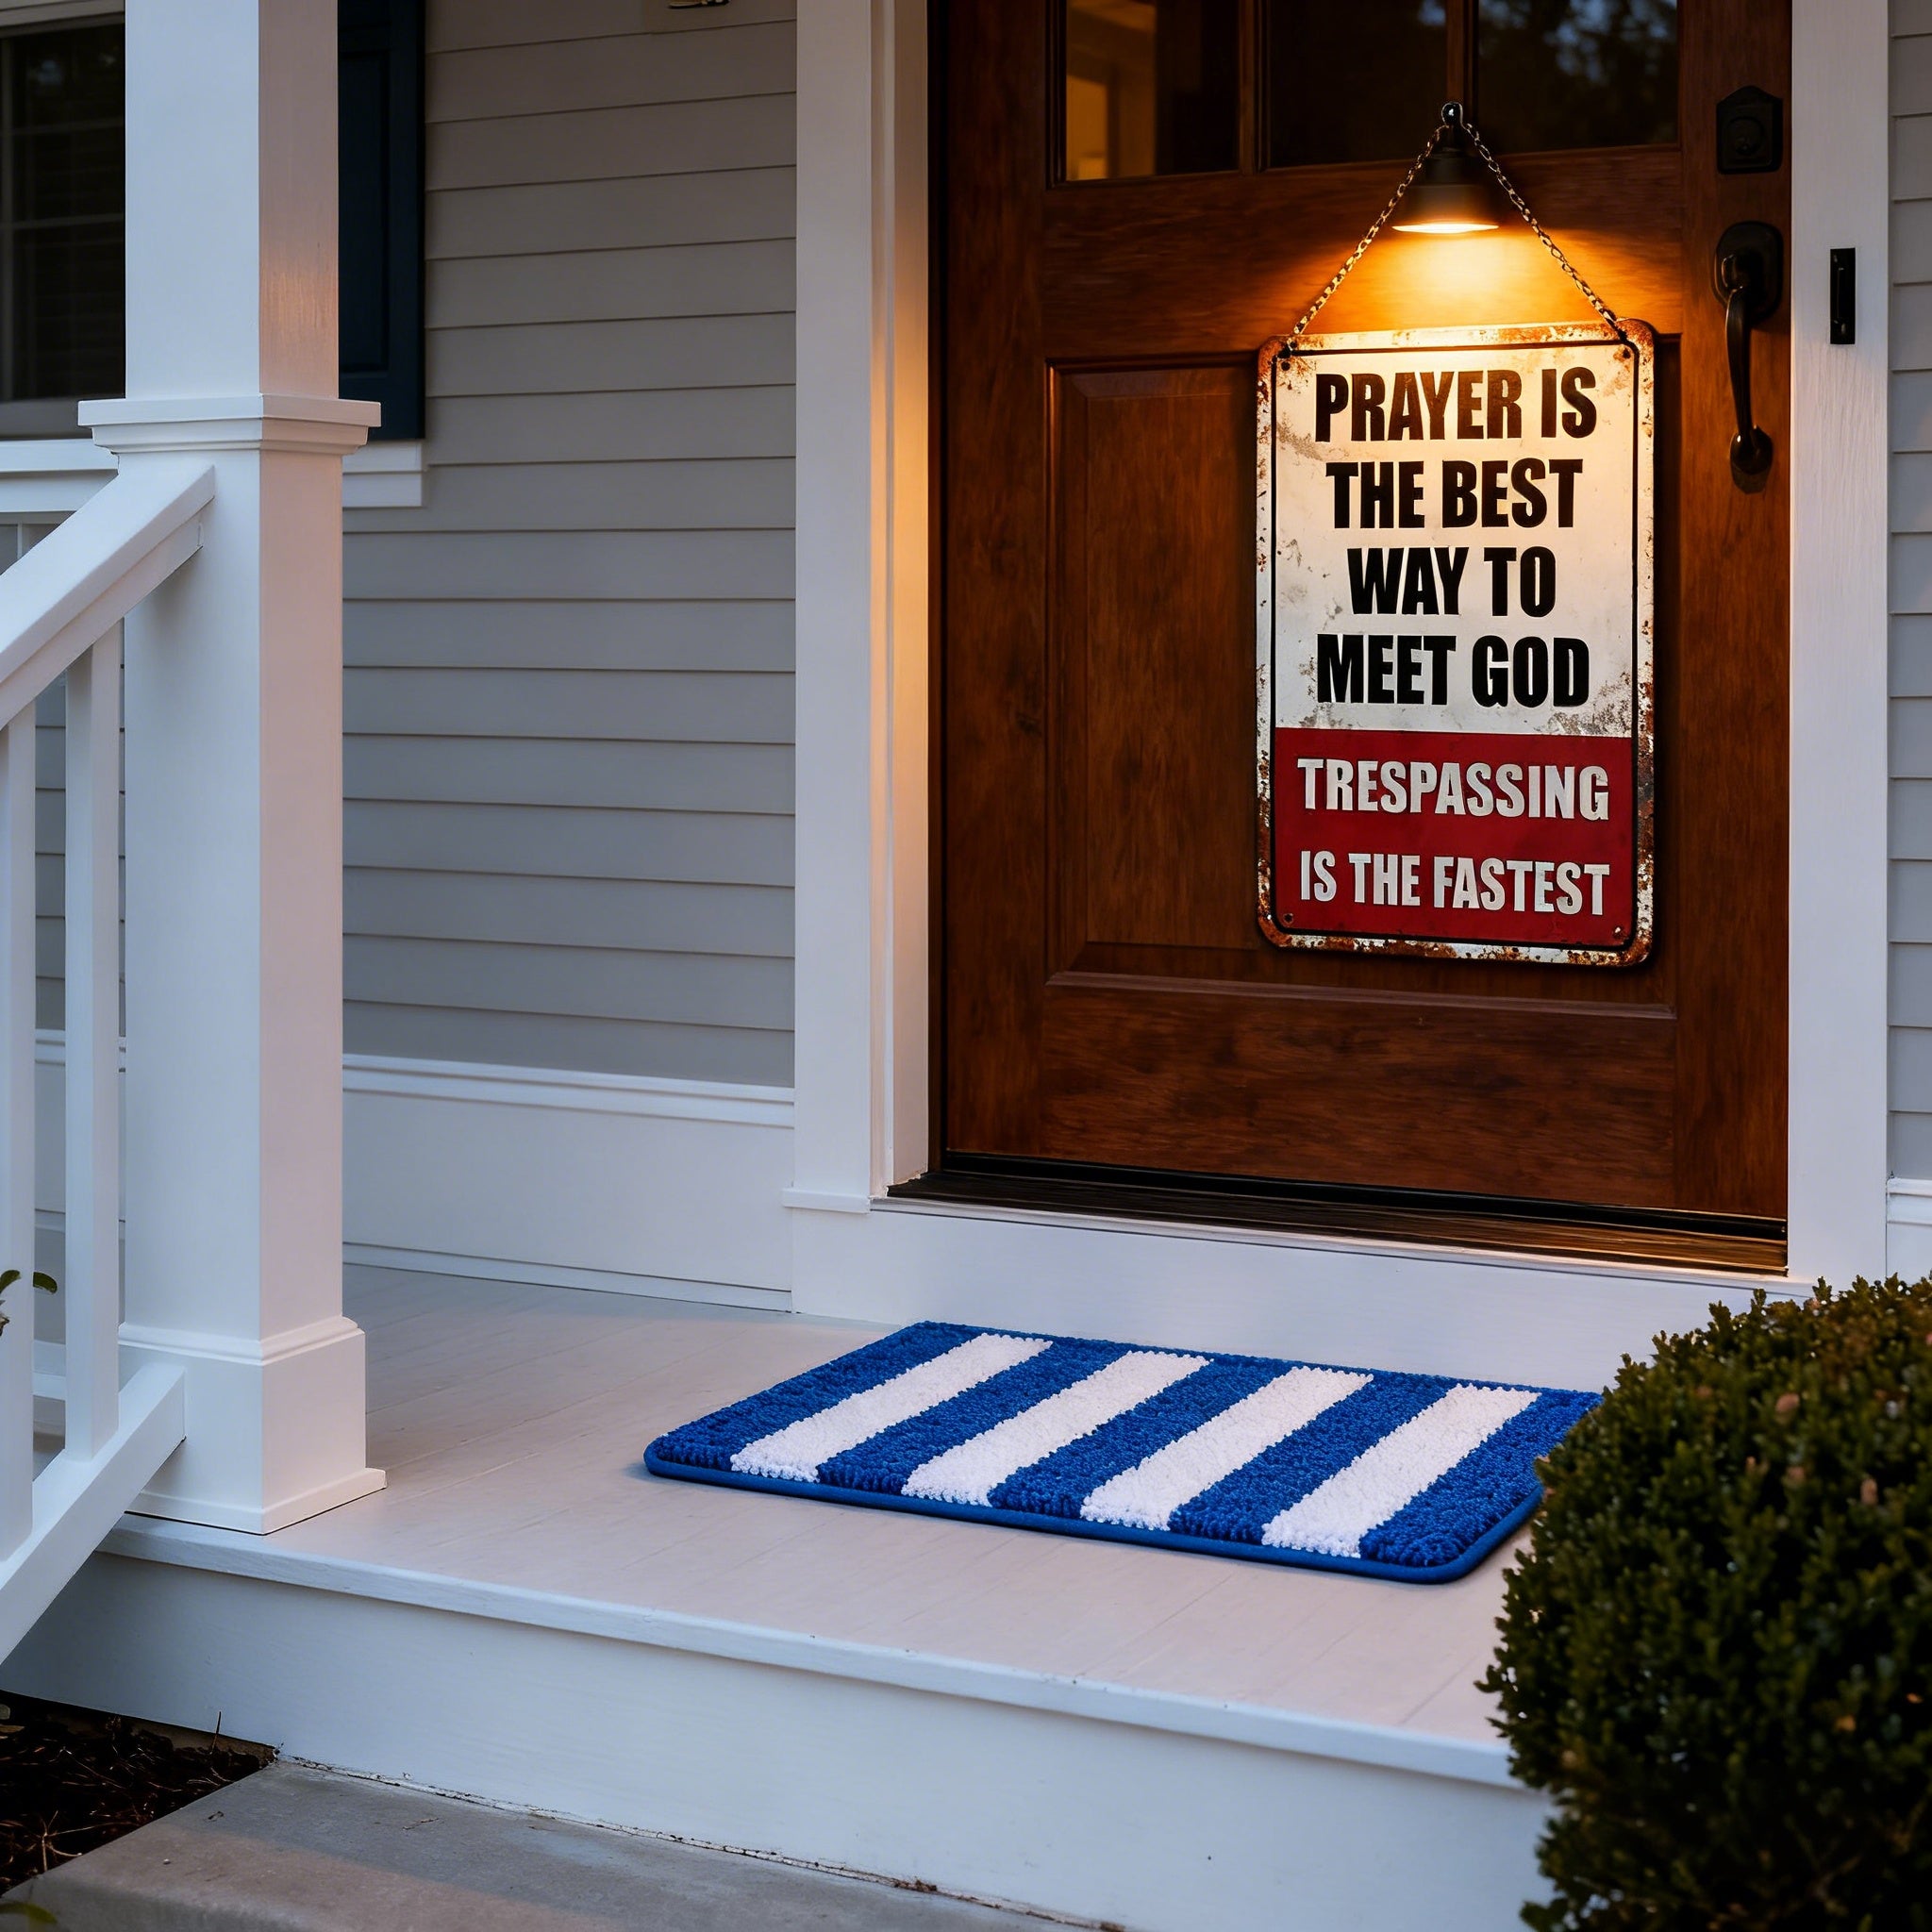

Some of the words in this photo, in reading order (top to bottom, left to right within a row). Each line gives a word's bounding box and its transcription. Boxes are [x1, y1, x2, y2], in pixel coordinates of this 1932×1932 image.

[1315, 370, 1522, 441] PRAYER
[1541, 367, 1596, 439] IS
[1325, 461, 1424, 528] THE
[1441, 458, 1583, 528] BEST
[1347, 546, 1469, 615] WAY
[1484, 546, 1556, 617] TO
[1317, 634, 1457, 705] MEET
[1472, 635, 1590, 708] GOD
[1297, 758, 1609, 821] TRESPASSING
[1301, 851, 1335, 901] IS
[1348, 853, 1421, 907] THE
[1433, 857, 1610, 916] FASTEST
